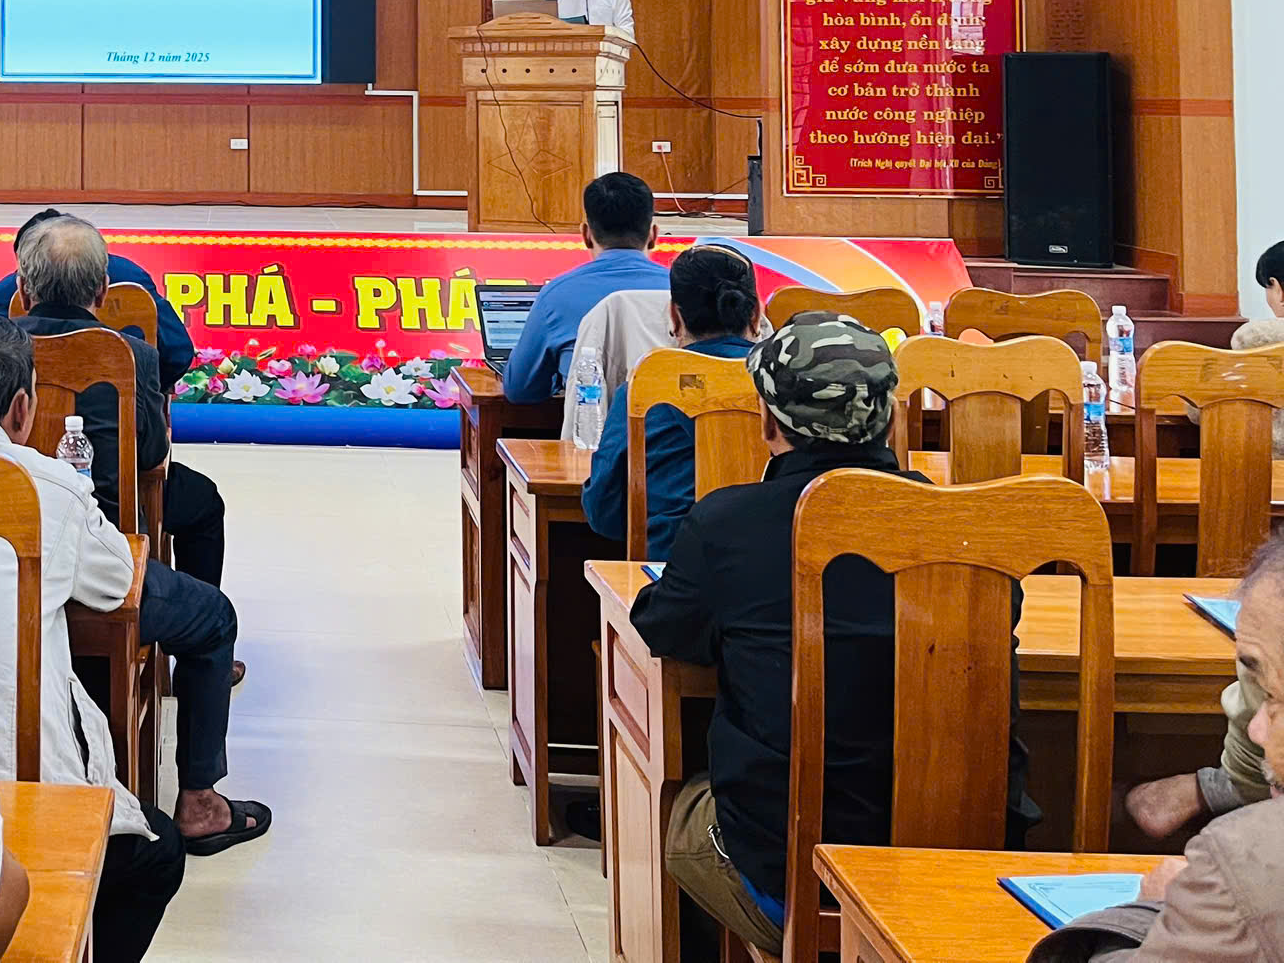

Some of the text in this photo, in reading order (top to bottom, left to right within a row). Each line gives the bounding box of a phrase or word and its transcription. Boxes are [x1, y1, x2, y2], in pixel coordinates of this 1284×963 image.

[823, 11, 932, 28] hòa bình, ổn
[819, 34, 940, 53] xây dựng nền
[107, 52, 209, 64] Tháng 12 năm 2025
[844, 59, 879, 73] sớm
[884, 60, 918, 73] đưa
[923, 59, 965, 73] nước
[972, 61, 989, 73] ta
[828, 82, 980, 97] cơ bản trở thành
[825, 106, 985, 123] nước công nghiệp
[809, 130, 848, 143] theo
[853, 131, 910, 147] hướng
[164, 264, 295, 327] PHÁ
[354, 268, 527, 330] PHÁ
